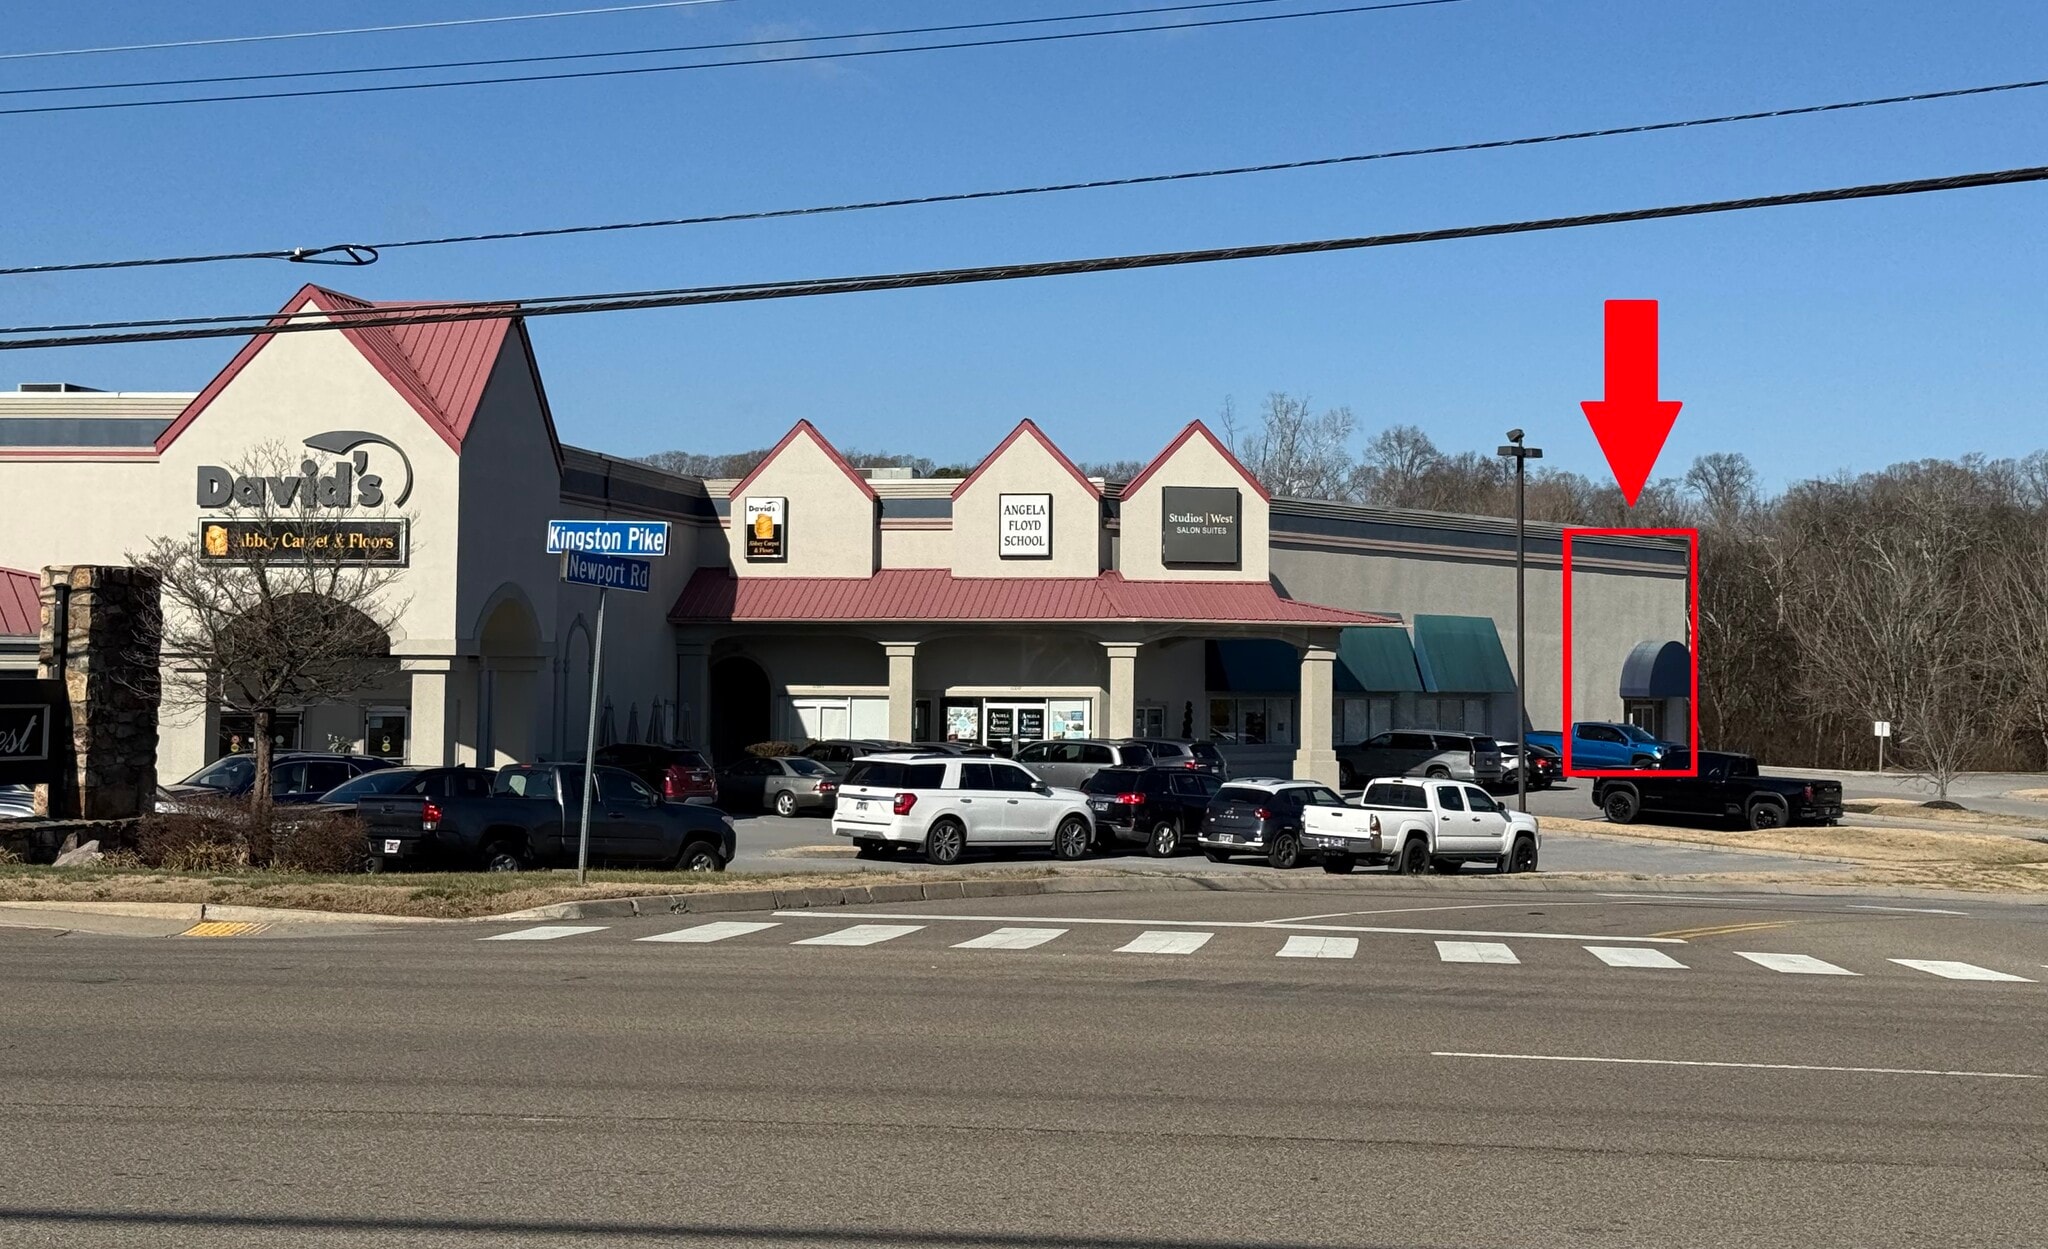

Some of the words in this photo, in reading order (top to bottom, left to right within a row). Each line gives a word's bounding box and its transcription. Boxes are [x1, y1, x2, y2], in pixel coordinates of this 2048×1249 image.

[197, 451, 384, 508] David's
[1003, 504, 1046, 516] ANGELA
[1168, 512, 1204, 523] Studios
[1210, 513, 1234, 524] West
[1008, 519, 1042, 531] FLOYD
[1176, 526, 1201, 534] SALON
[1202, 526, 1227, 535] SUITES
[239, 532, 280, 551] bbey
[282, 532, 328, 548] Caret
[349, 532, 394, 549] Floors
[549, 525, 622, 551] Kingston
[627, 526, 664, 551] Pike
[1003, 535, 1046, 547] SCHOOL
[569, 554, 626, 584] Newport
[630, 563, 649, 588] Rd
